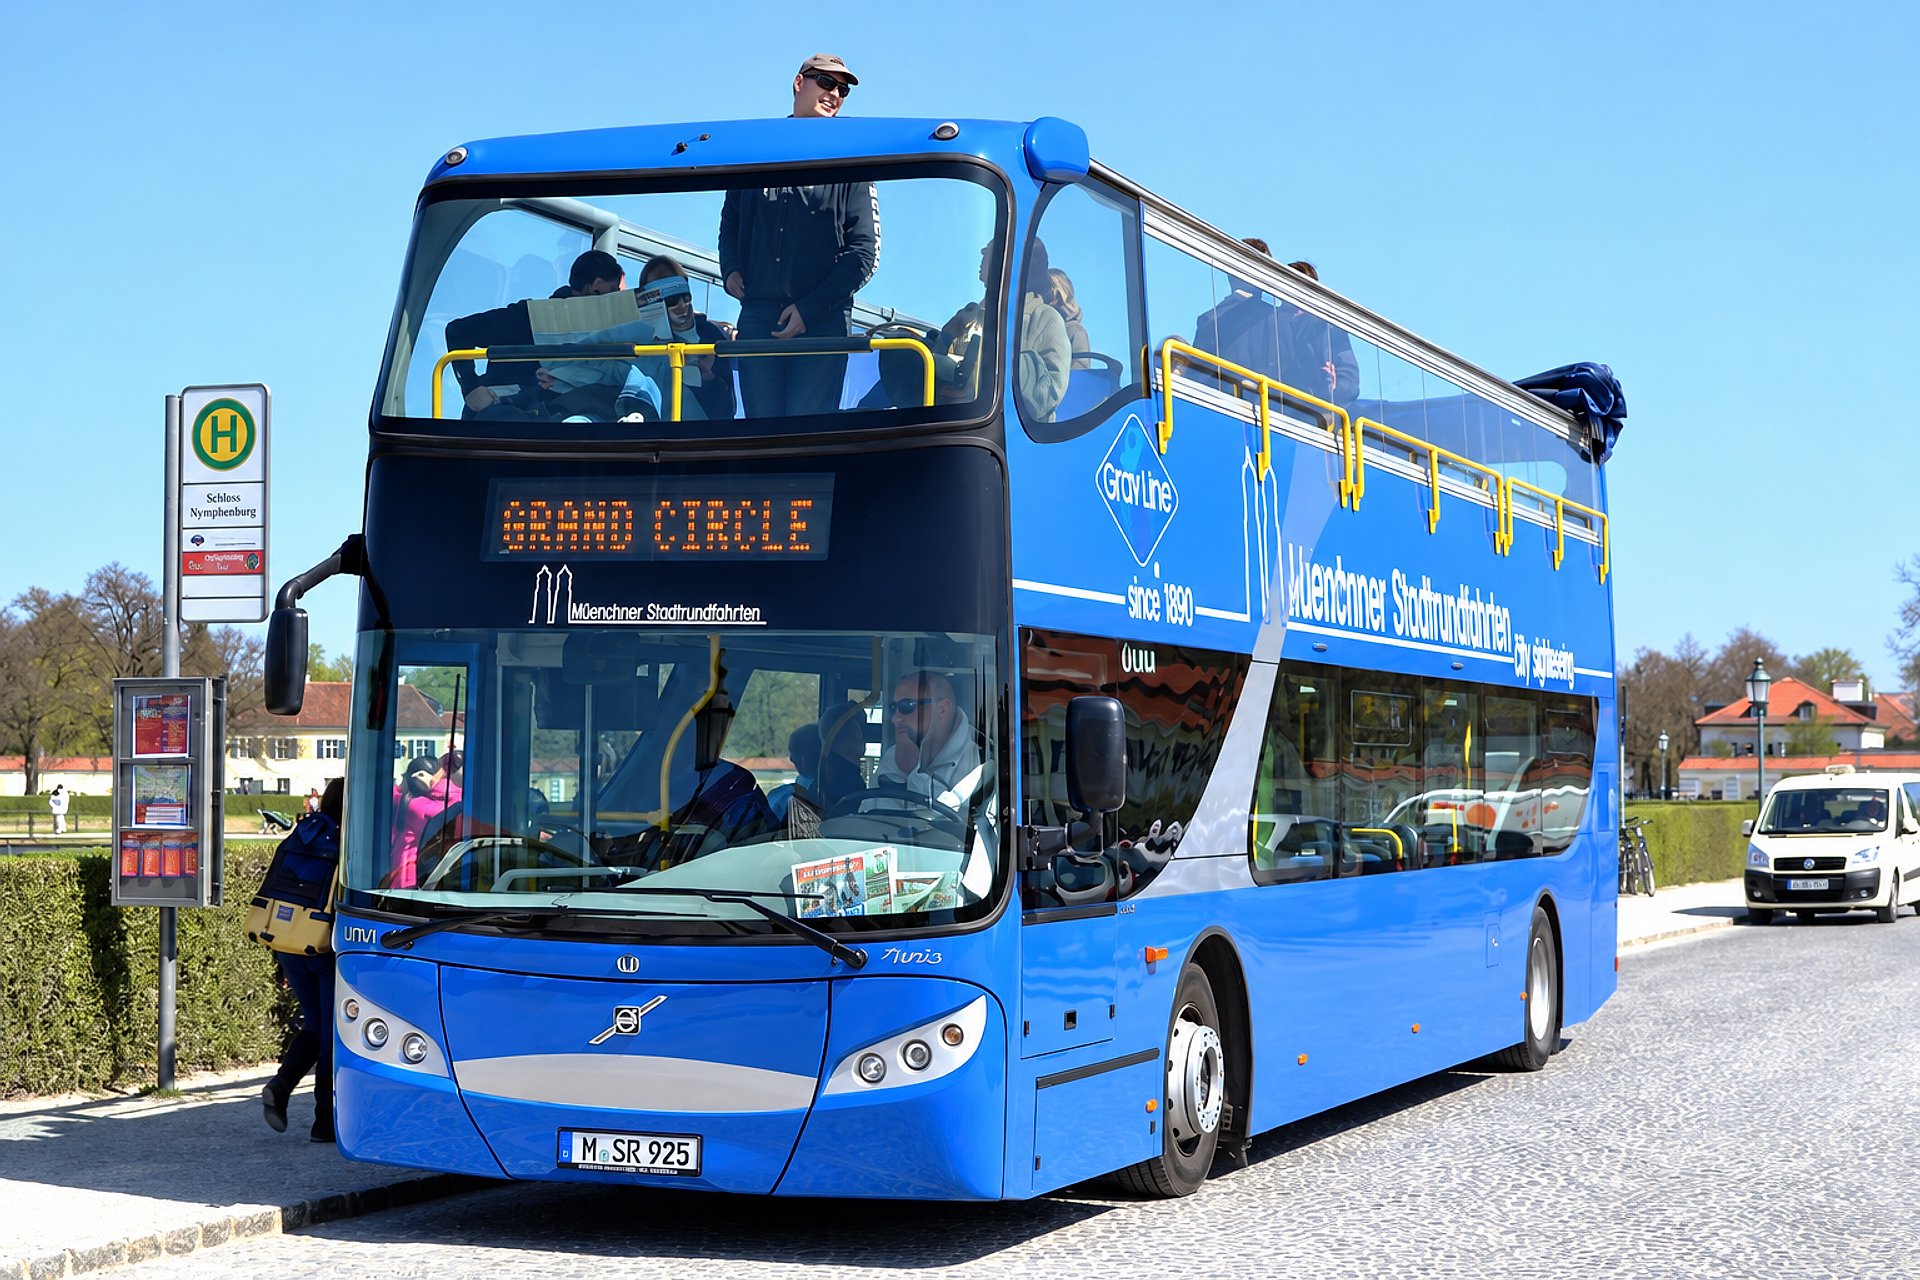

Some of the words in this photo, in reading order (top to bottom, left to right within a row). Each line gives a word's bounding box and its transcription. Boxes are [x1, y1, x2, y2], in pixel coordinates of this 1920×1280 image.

[210, 414, 237, 454] H
[206, 492, 241, 503] Schloss
[1141, 469, 1173, 513] Line
[190, 506, 257, 520] Nymphenburg
[503, 499, 633, 550] GRAND
[654, 499, 812, 550] CIRCLE
[646, 602, 761, 621] Stadtrundfahrten
[1127, 575, 1161, 622] since
[1163, 583, 1194, 627] 1890
[1391, 567, 1512, 654] Stadtrundfahrten
[581, 1136, 598, 1162] M
[612, 1138, 641, 1164] SR
[648, 1140, 691, 1166] 925
